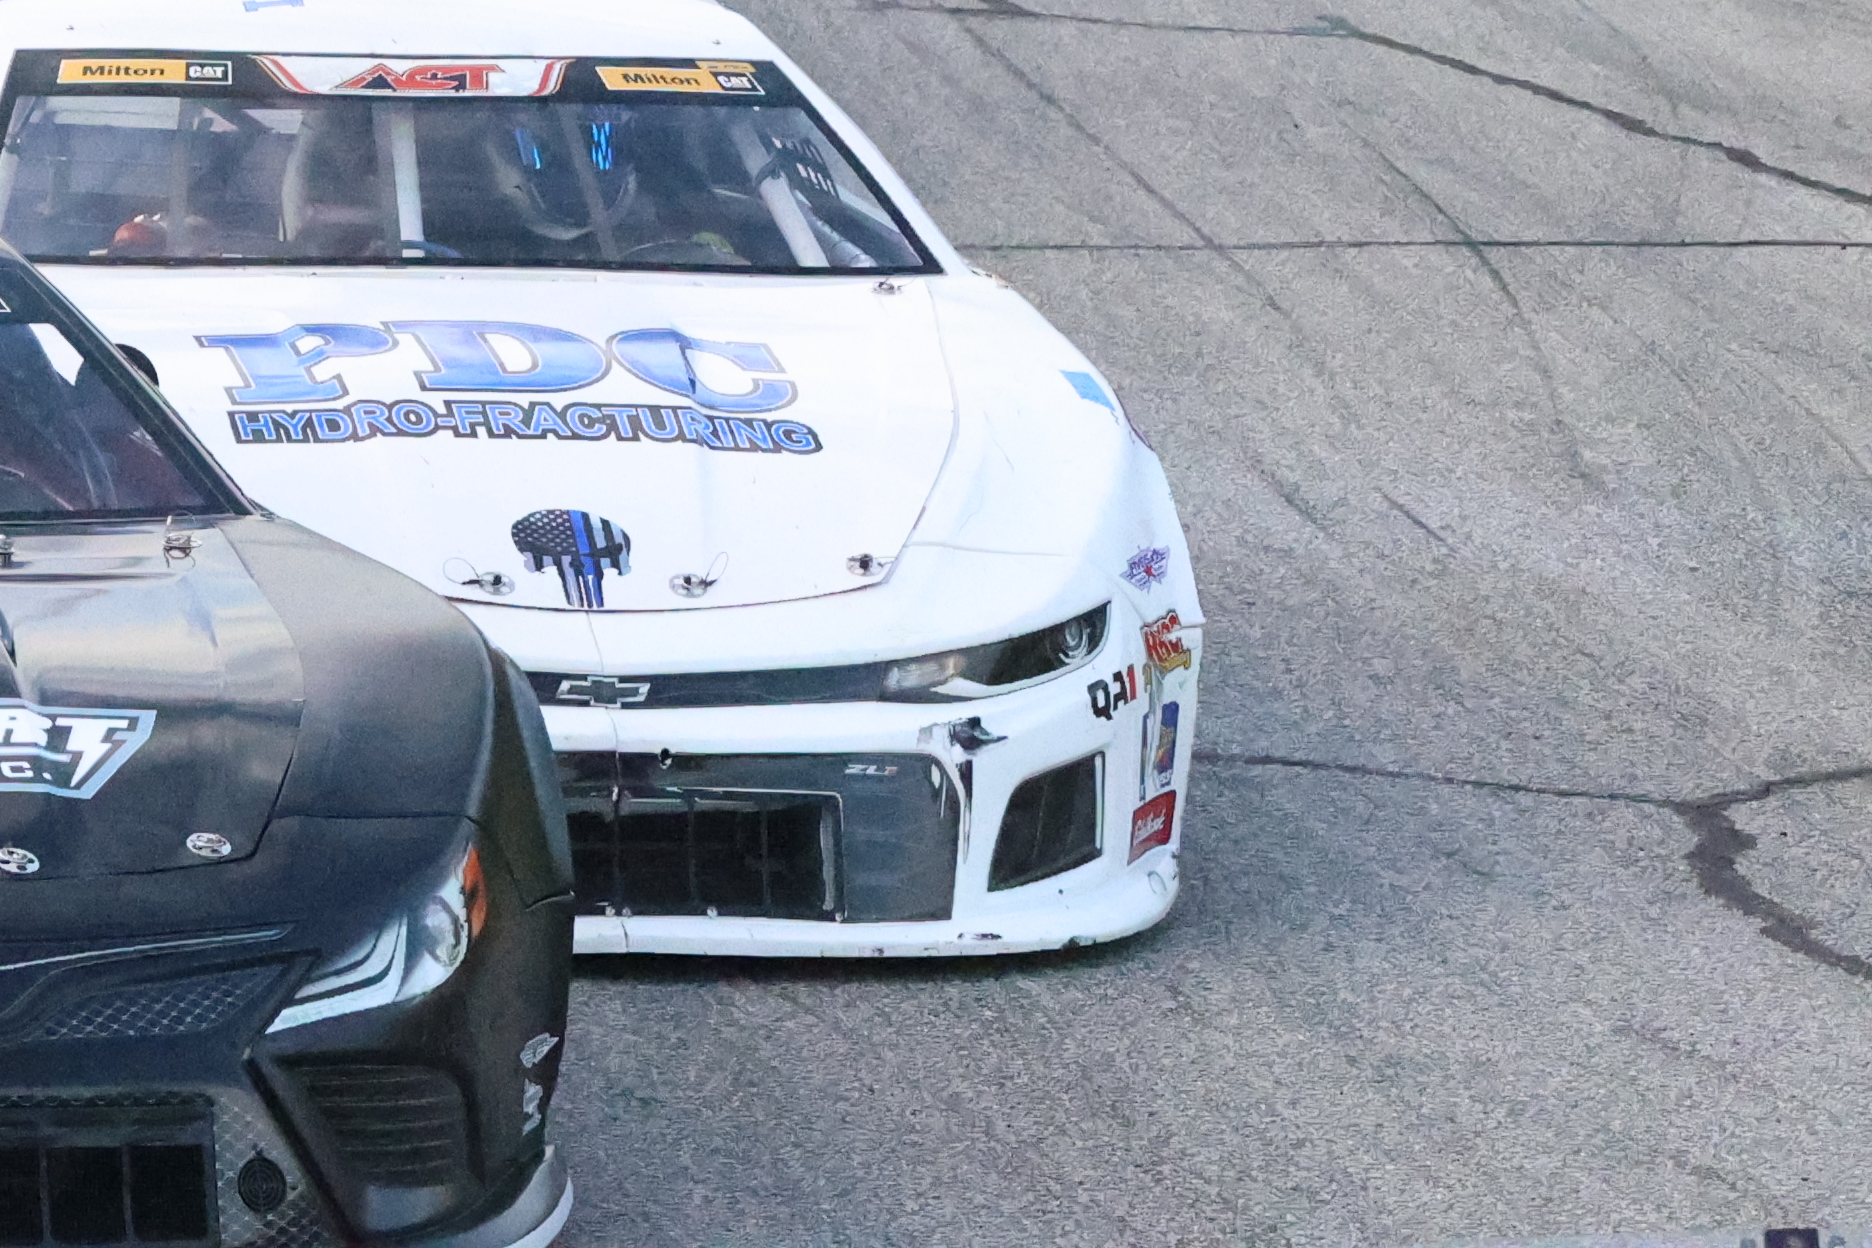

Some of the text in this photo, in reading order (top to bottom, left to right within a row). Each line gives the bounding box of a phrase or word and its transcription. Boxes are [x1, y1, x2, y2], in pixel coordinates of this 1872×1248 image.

[81, 64, 225, 79] Milton CAT
[330, 62, 506, 93] ACT
[621, 71, 752, 91] Milton CAT
[193, 320, 798, 414] PDC
[227, 399, 824, 455] HYDRO-FRACTURING
[1086, 662, 1138, 721] QA1
